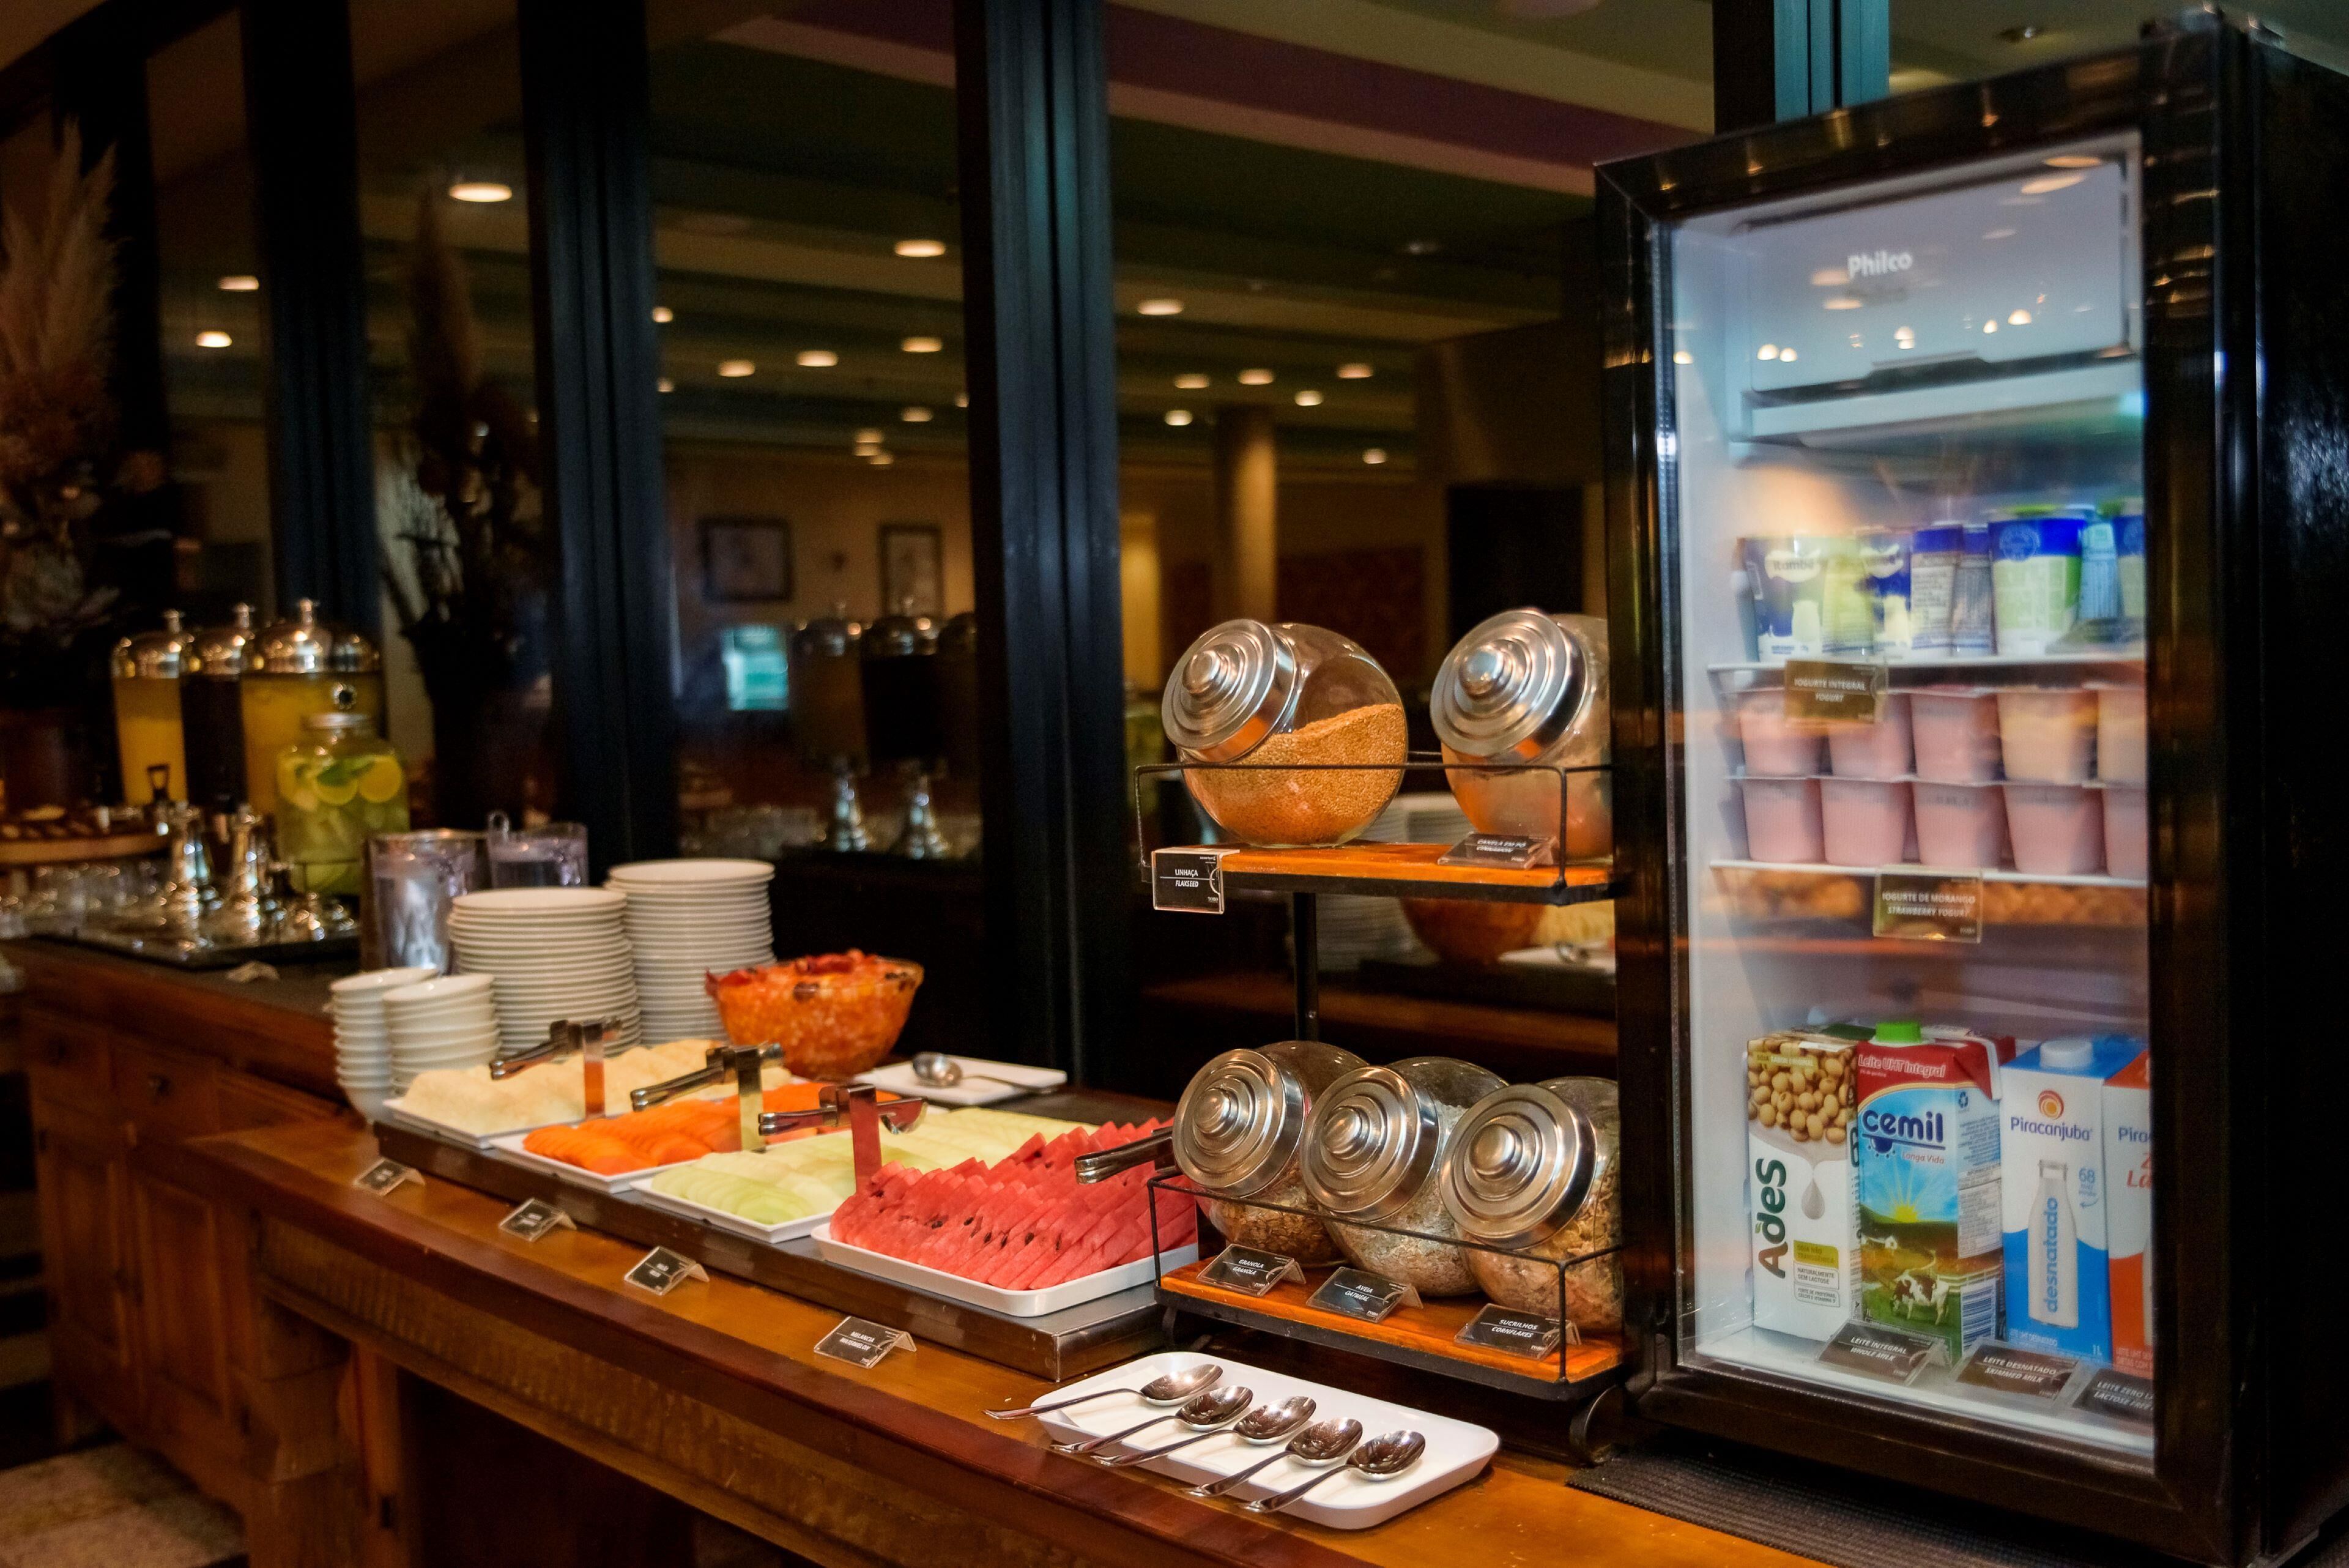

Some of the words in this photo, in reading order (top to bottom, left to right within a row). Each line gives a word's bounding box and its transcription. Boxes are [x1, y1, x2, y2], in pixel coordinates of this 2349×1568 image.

[1847, 250, 1913, 280] Philco
[1828, 680, 1866, 691] INTEGRAL
[1174, 869, 1198, 877] LINHAÇA
[1882, 891, 1918, 902] IOGURTE
[1918, 892, 1929, 902] DE
[1931, 893, 1976, 904] MORANGO
[1887, 906, 1936, 916] STRAWBERRY
[1938, 908, 1970, 917] YOGURT
[1858, 1053, 1882, 1069] Leite
[1882, 1057, 1905, 1071] UHT
[1906, 1061, 1946, 1079] Integral
[2010, 1117, 2090, 1142] Piracanjuba
[1902, 1151, 1926, 1163] Longa
[1927, 1155, 1945, 1164] Vida
[2079, 1167, 2096, 1184] 68
[2042, 1196, 2058, 1313] desnatado
[1239, 1258, 1264, 1269] GRANOLA
[1232, 1266, 1257, 1275] GRANOLA
[1797, 1268, 1835, 1278] NATURALMENTE
[1809, 1276, 1830, 1285] LACTOSE
[1345, 1291, 1370, 1301] OATMEAL
[1355, 1285, 1373, 1294] AVEIA
[1499, 1319, 1538, 1330] SUCRILHOS
[850, 1331, 875, 1343] MELANCIA
[1491, 1326, 1534, 1338] CORNFLAKES
[839, 1337, 871, 1351] WATERMELON
[1850, 1336, 1871, 1347] LEITE
[1871, 1340, 1907, 1354] INTEGRAL
[1849, 1347, 1876, 1358] WHOLE
[1876, 1351, 1896, 1362] MILK
[1983, 1356, 2006, 1367] LEITE
[2005, 1361, 2057, 1375] DESNATADO
[1984, 1367, 2022, 1380] SKIMMED
[2022, 1373, 2044, 1383] MILK
[2096, 1381, 2120, 1392] LEITE
[2120, 1387, 2144, 1398] ZERO
[2093, 1391, 2130, 1405] LACTOSE
